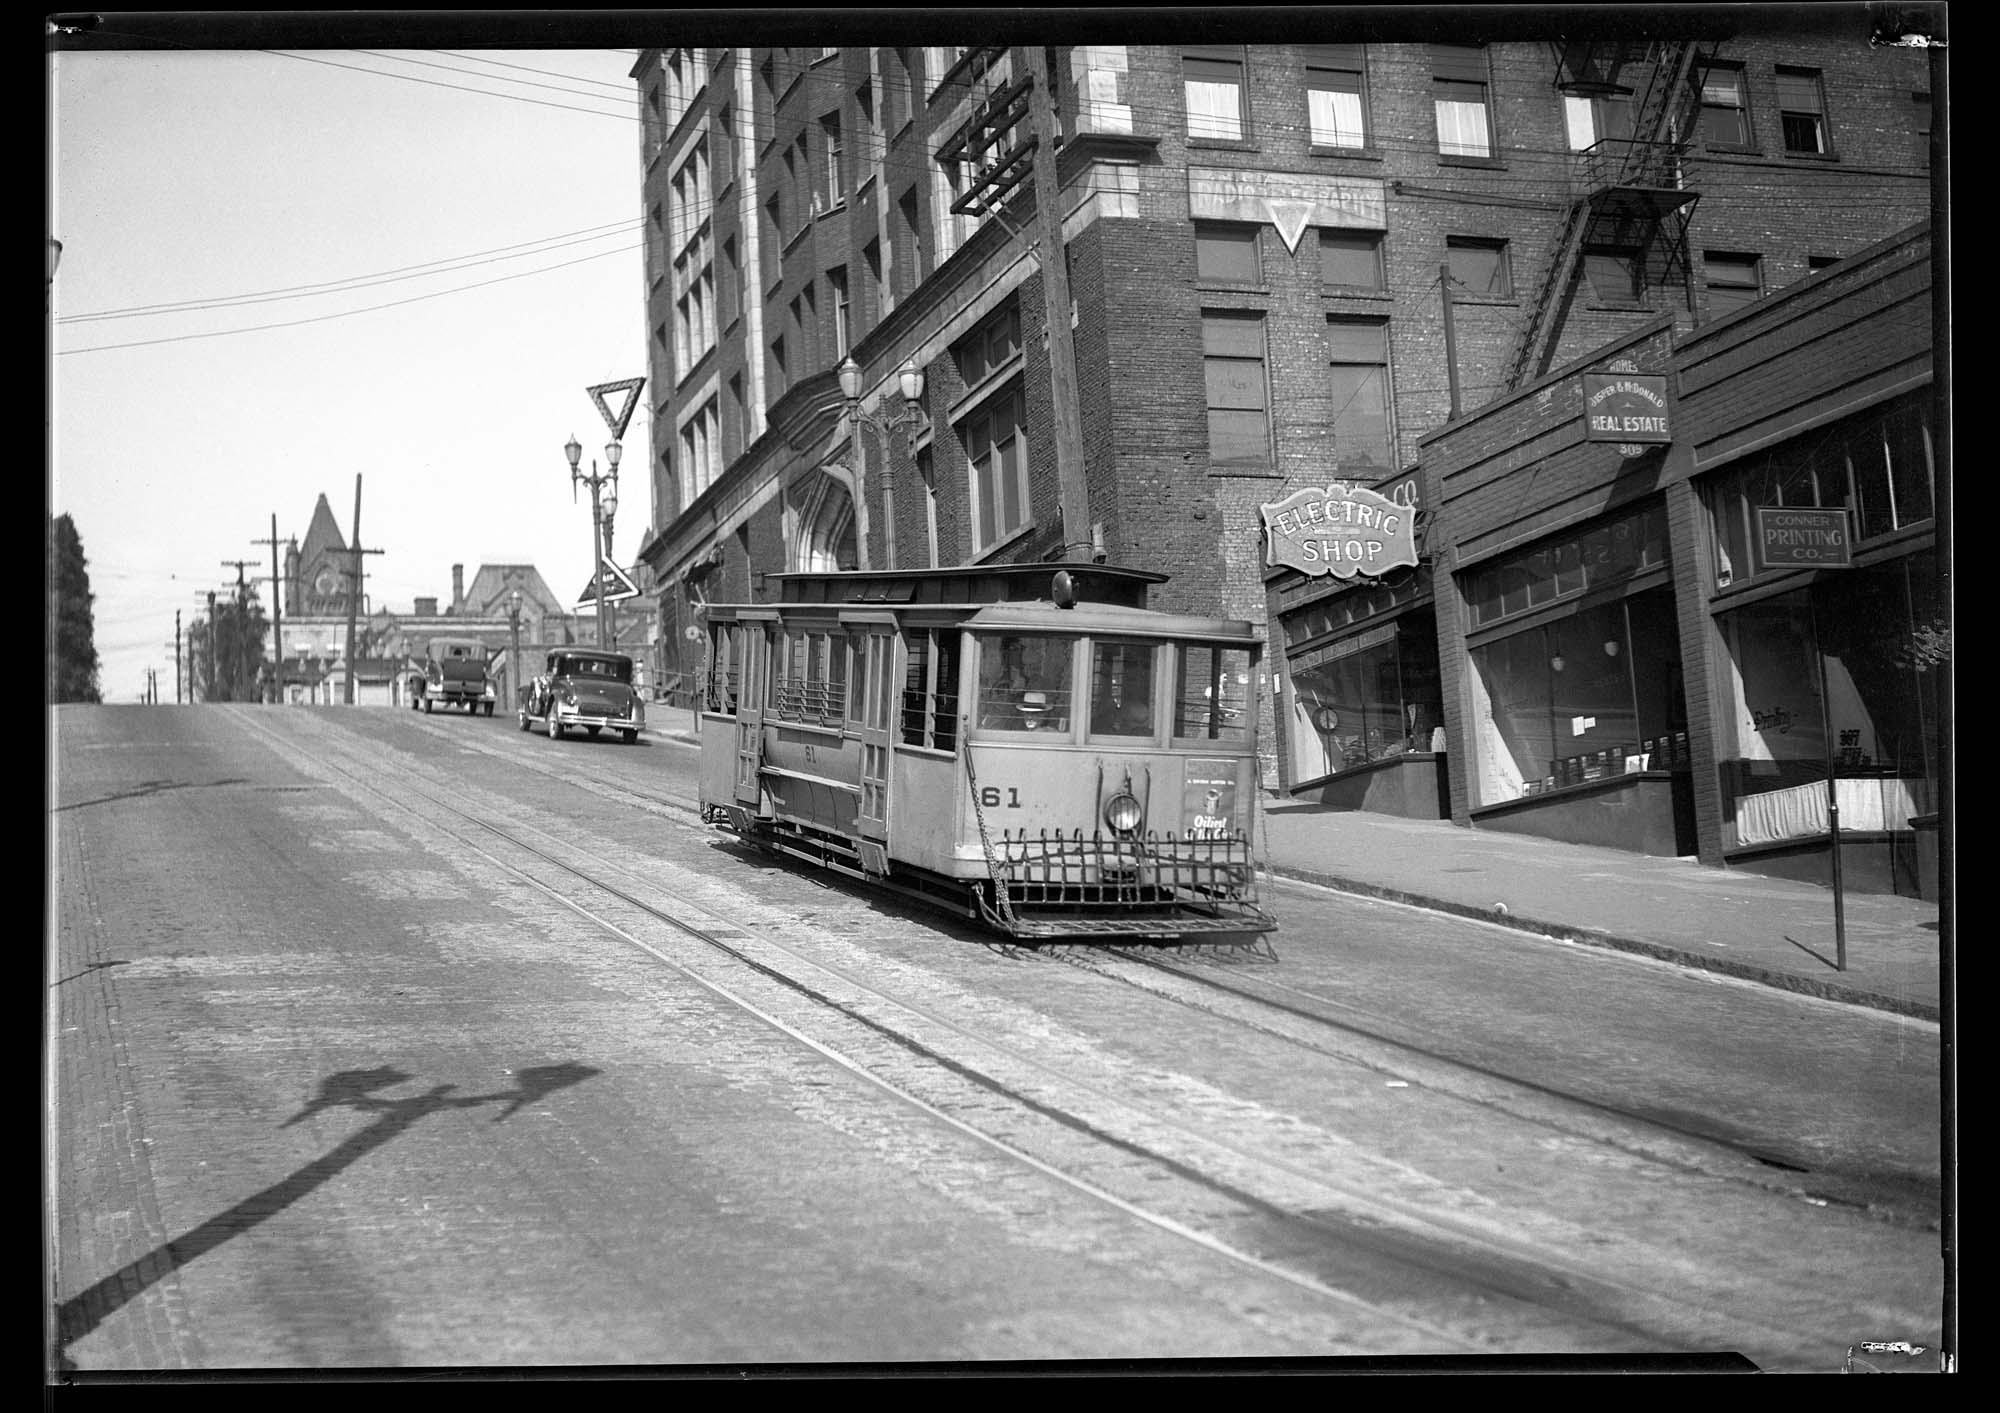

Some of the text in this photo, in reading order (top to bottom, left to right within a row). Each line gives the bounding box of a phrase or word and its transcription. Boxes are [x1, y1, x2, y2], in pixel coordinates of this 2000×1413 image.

[1609, 359, 1639, 373] HOMES
[1617, 381, 1624, 393] &
[1592, 415, 1667, 433] REAL ESTATE
[1619, 443, 1643, 456] 309
[1275, 500, 1399, 536] ELECTRIC
[1775, 516, 1830, 526] CONNER
[1766, 529, 1842, 546] PRINTING
[1302, 539, 1384, 562] SHOP
[1792, 548, 1823, 559] CO.
[804, 745, 817, 764] 61
[981, 786, 1021, 809] 61
